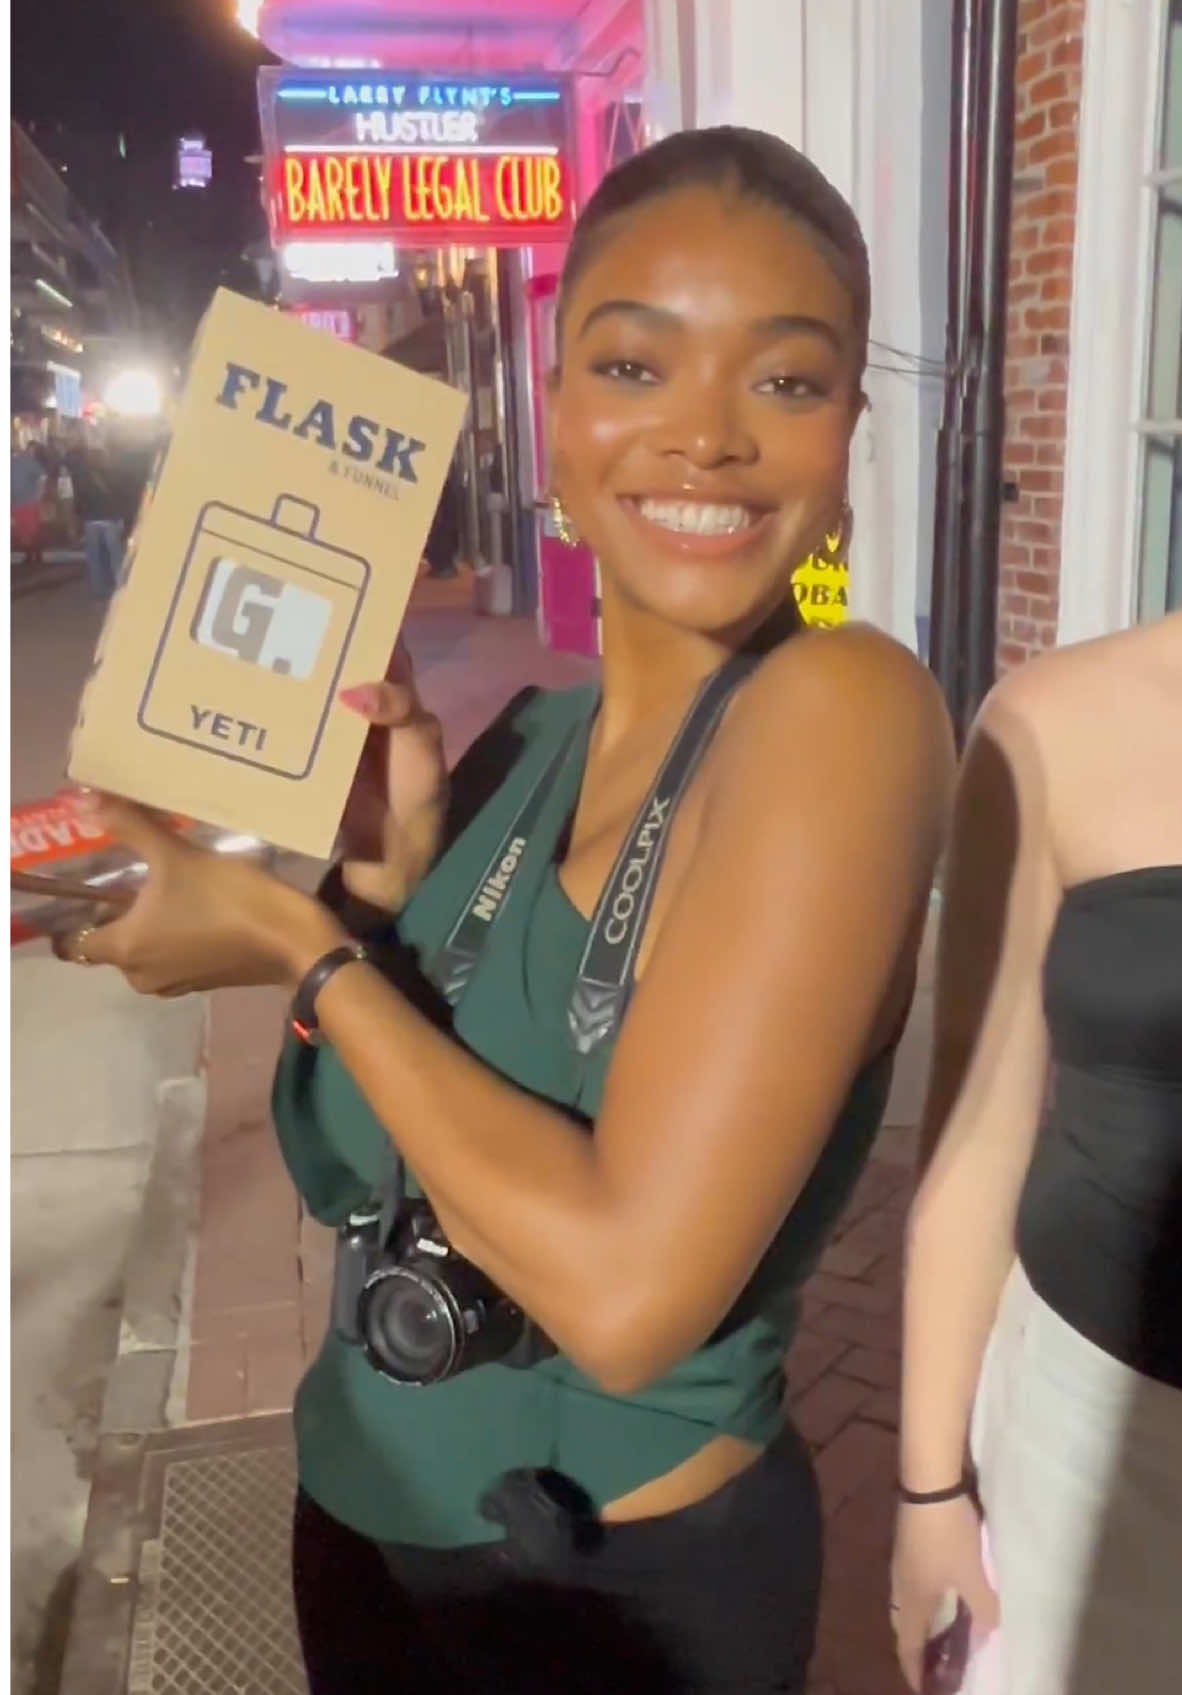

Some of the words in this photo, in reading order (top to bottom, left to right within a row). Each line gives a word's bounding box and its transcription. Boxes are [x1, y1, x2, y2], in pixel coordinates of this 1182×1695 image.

[328, 85, 406, 105] LARRY
[419, 85, 513, 106] FLYNT'S
[355, 111, 479, 142] HUSTLER
[285, 154, 392, 222] BARELY
[403, 154, 490, 222] LEGAL
[496, 155, 563, 221] CLUB
[215, 362, 426, 483] FLASK
[189, 704, 268, 752] YETI
[472, 836, 527, 922] Nikon
[604, 796, 671, 944] COOLPIX
